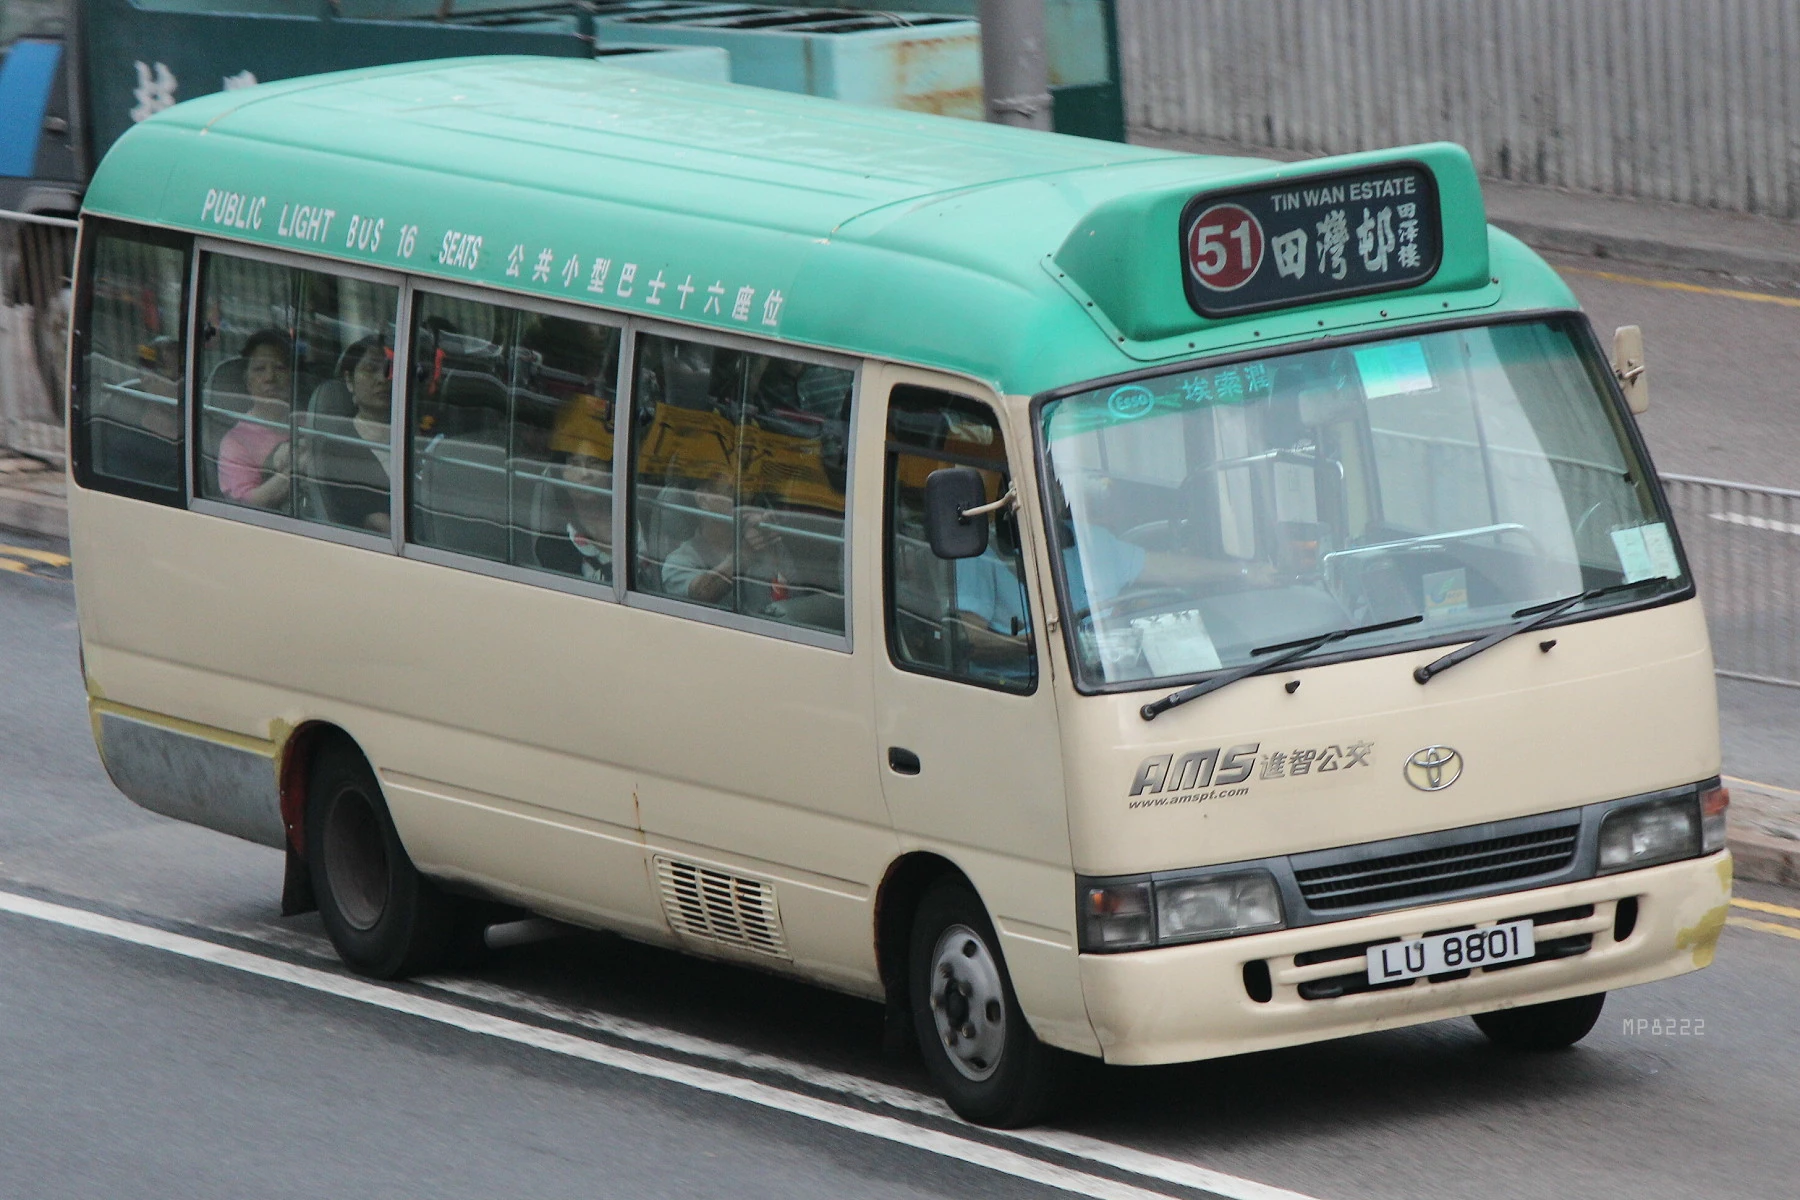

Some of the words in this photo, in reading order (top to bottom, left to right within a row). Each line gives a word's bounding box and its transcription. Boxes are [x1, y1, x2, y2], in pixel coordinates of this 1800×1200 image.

[1271, 193, 1300, 212] TIN
[1304, 185, 1345, 207] WAN
[1350, 176, 1416, 200] ESTATE
[201, 188, 266, 230] PUBLIC
[278, 202, 335, 243] LIGHT
[345, 214, 384, 252] BUS
[397, 224, 418, 258] 16
[439, 229, 482, 271] SEATS
[1197, 220, 1252, 275] 51
[1271, 205, 1395, 281] 田灣邨
[505, 243, 784, 327] 公共小型巴士十六座位
[1129, 742, 1260, 796] AMS
[1259, 740, 1375, 781] 進智公交
[1128, 786, 1249, 810] www.amspt.com
[1382, 942, 1425, 978] LU
[1443, 926, 1519, 966] 8801
